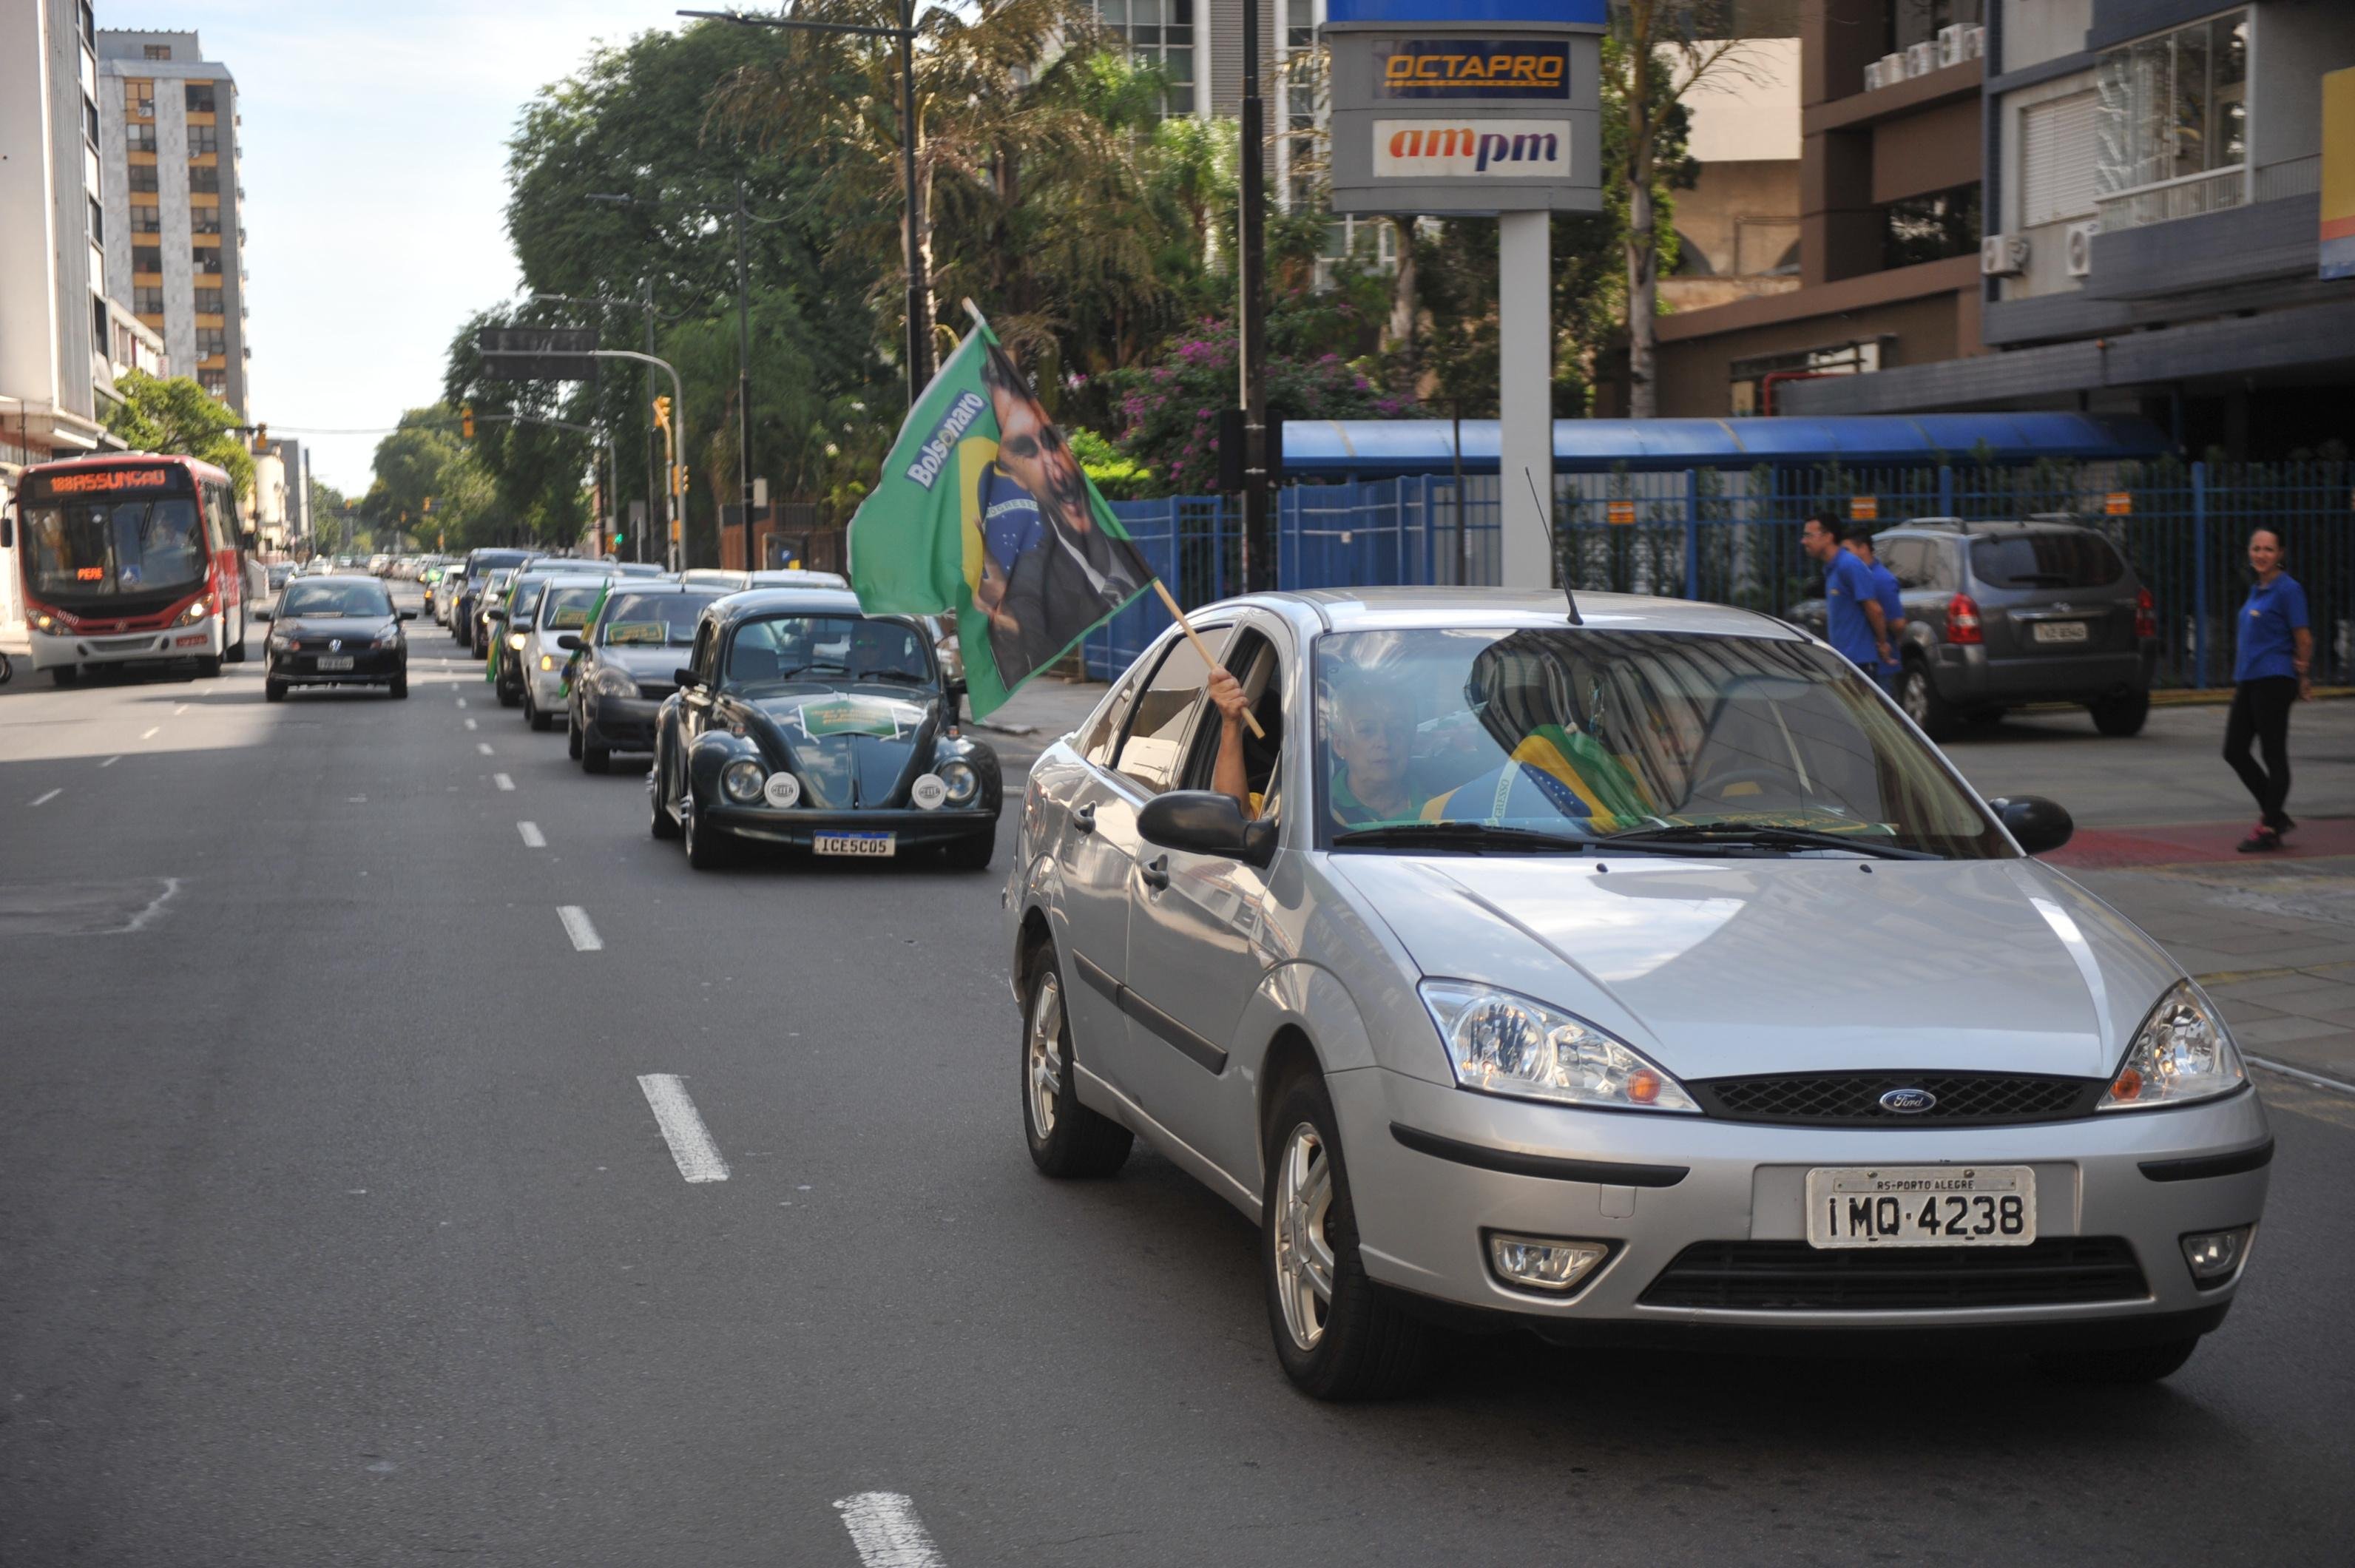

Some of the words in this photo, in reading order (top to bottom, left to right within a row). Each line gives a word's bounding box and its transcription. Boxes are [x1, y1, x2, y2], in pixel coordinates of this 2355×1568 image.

[1385, 55, 1564, 80] OCTAPRO
[1389, 127, 1558, 172] ampm
[907, 392, 984, 488] Bolsonaro
[987, 500, 1038, 516] OGRESSO
[821, 837, 887, 854] ICE5C05
[1893, 1093, 1924, 1108] Ford
[1934, 1180, 1974, 1190] ALEGRE
